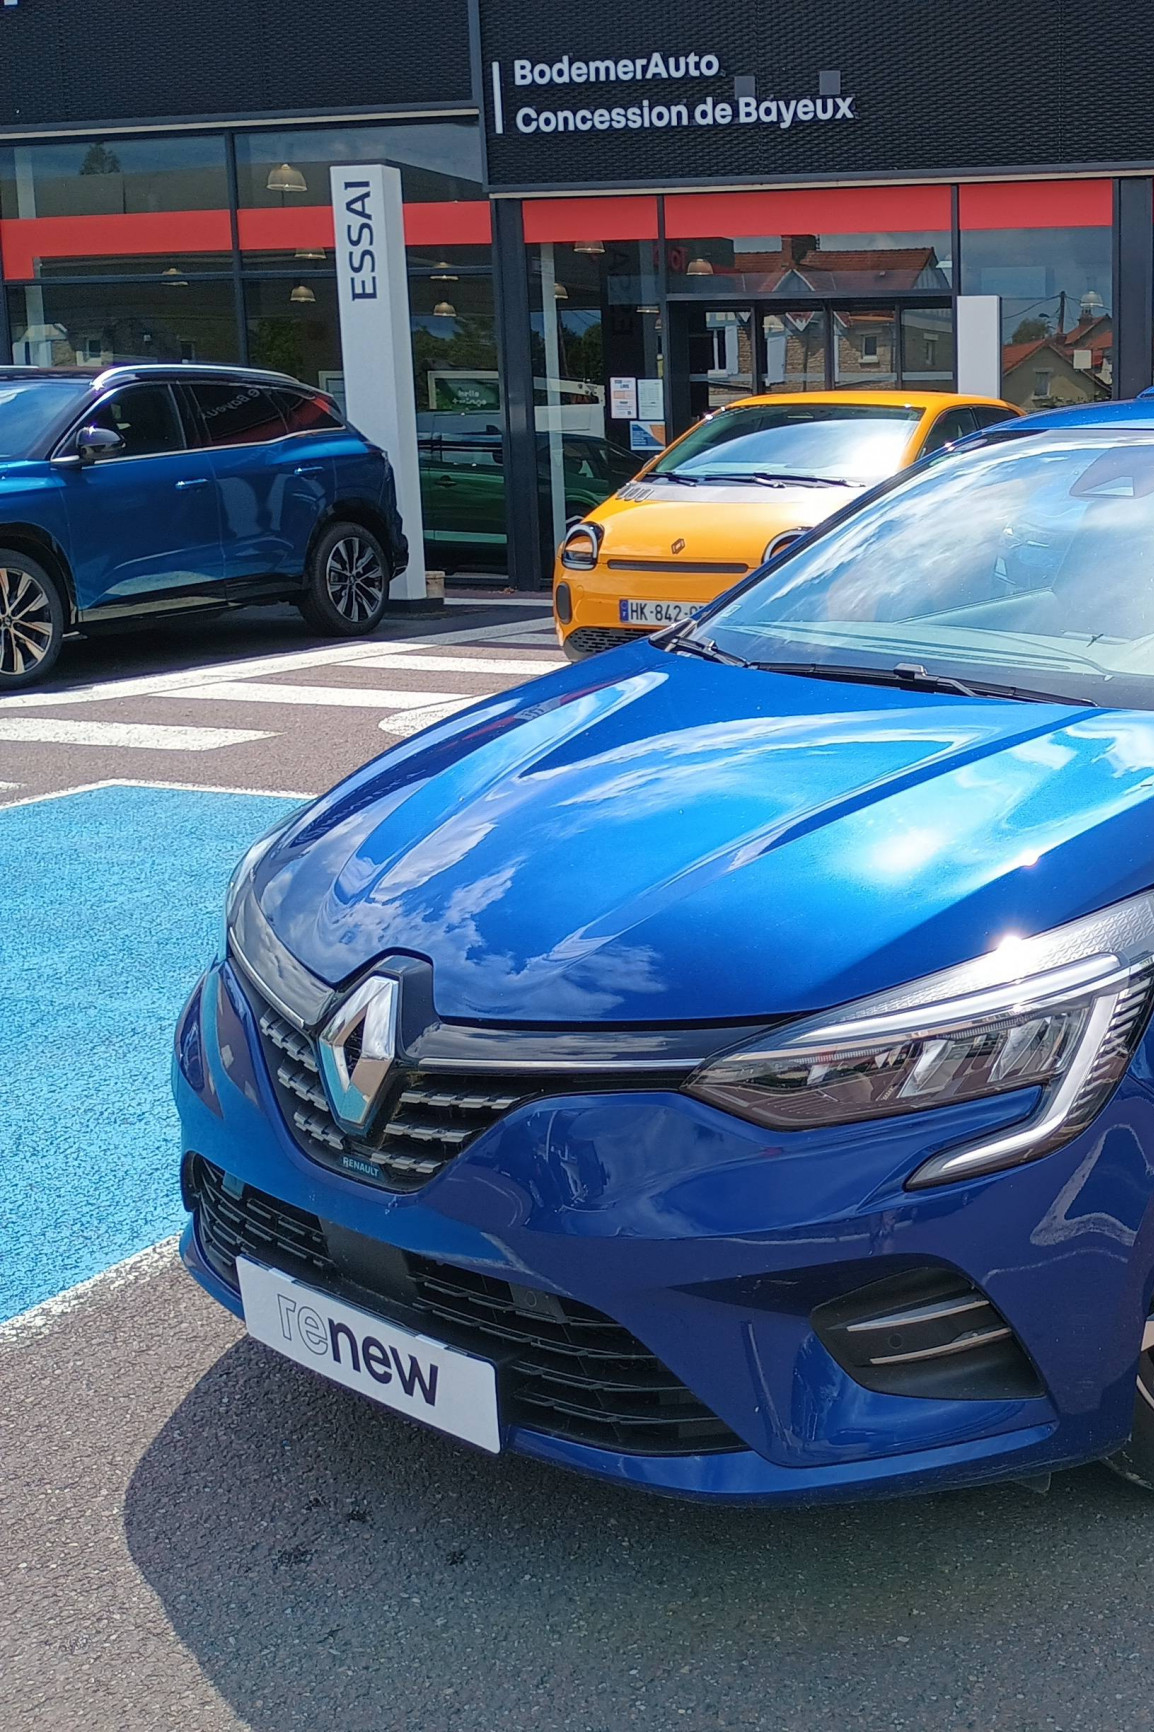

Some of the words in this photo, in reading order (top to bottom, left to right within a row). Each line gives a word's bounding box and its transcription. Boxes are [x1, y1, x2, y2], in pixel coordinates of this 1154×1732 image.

[514, 52, 720, 86] BodemerAuto
[516, 99, 689, 133] Concession
[694, 97, 732, 125] de
[738, 96, 855, 129] Bayeux
[344, 181, 377, 301] ESSAI
[630, 602, 707, 622] HK-842-
[342, 1156, 379, 1177] RENAULT
[277, 1293, 439, 1407] renew
